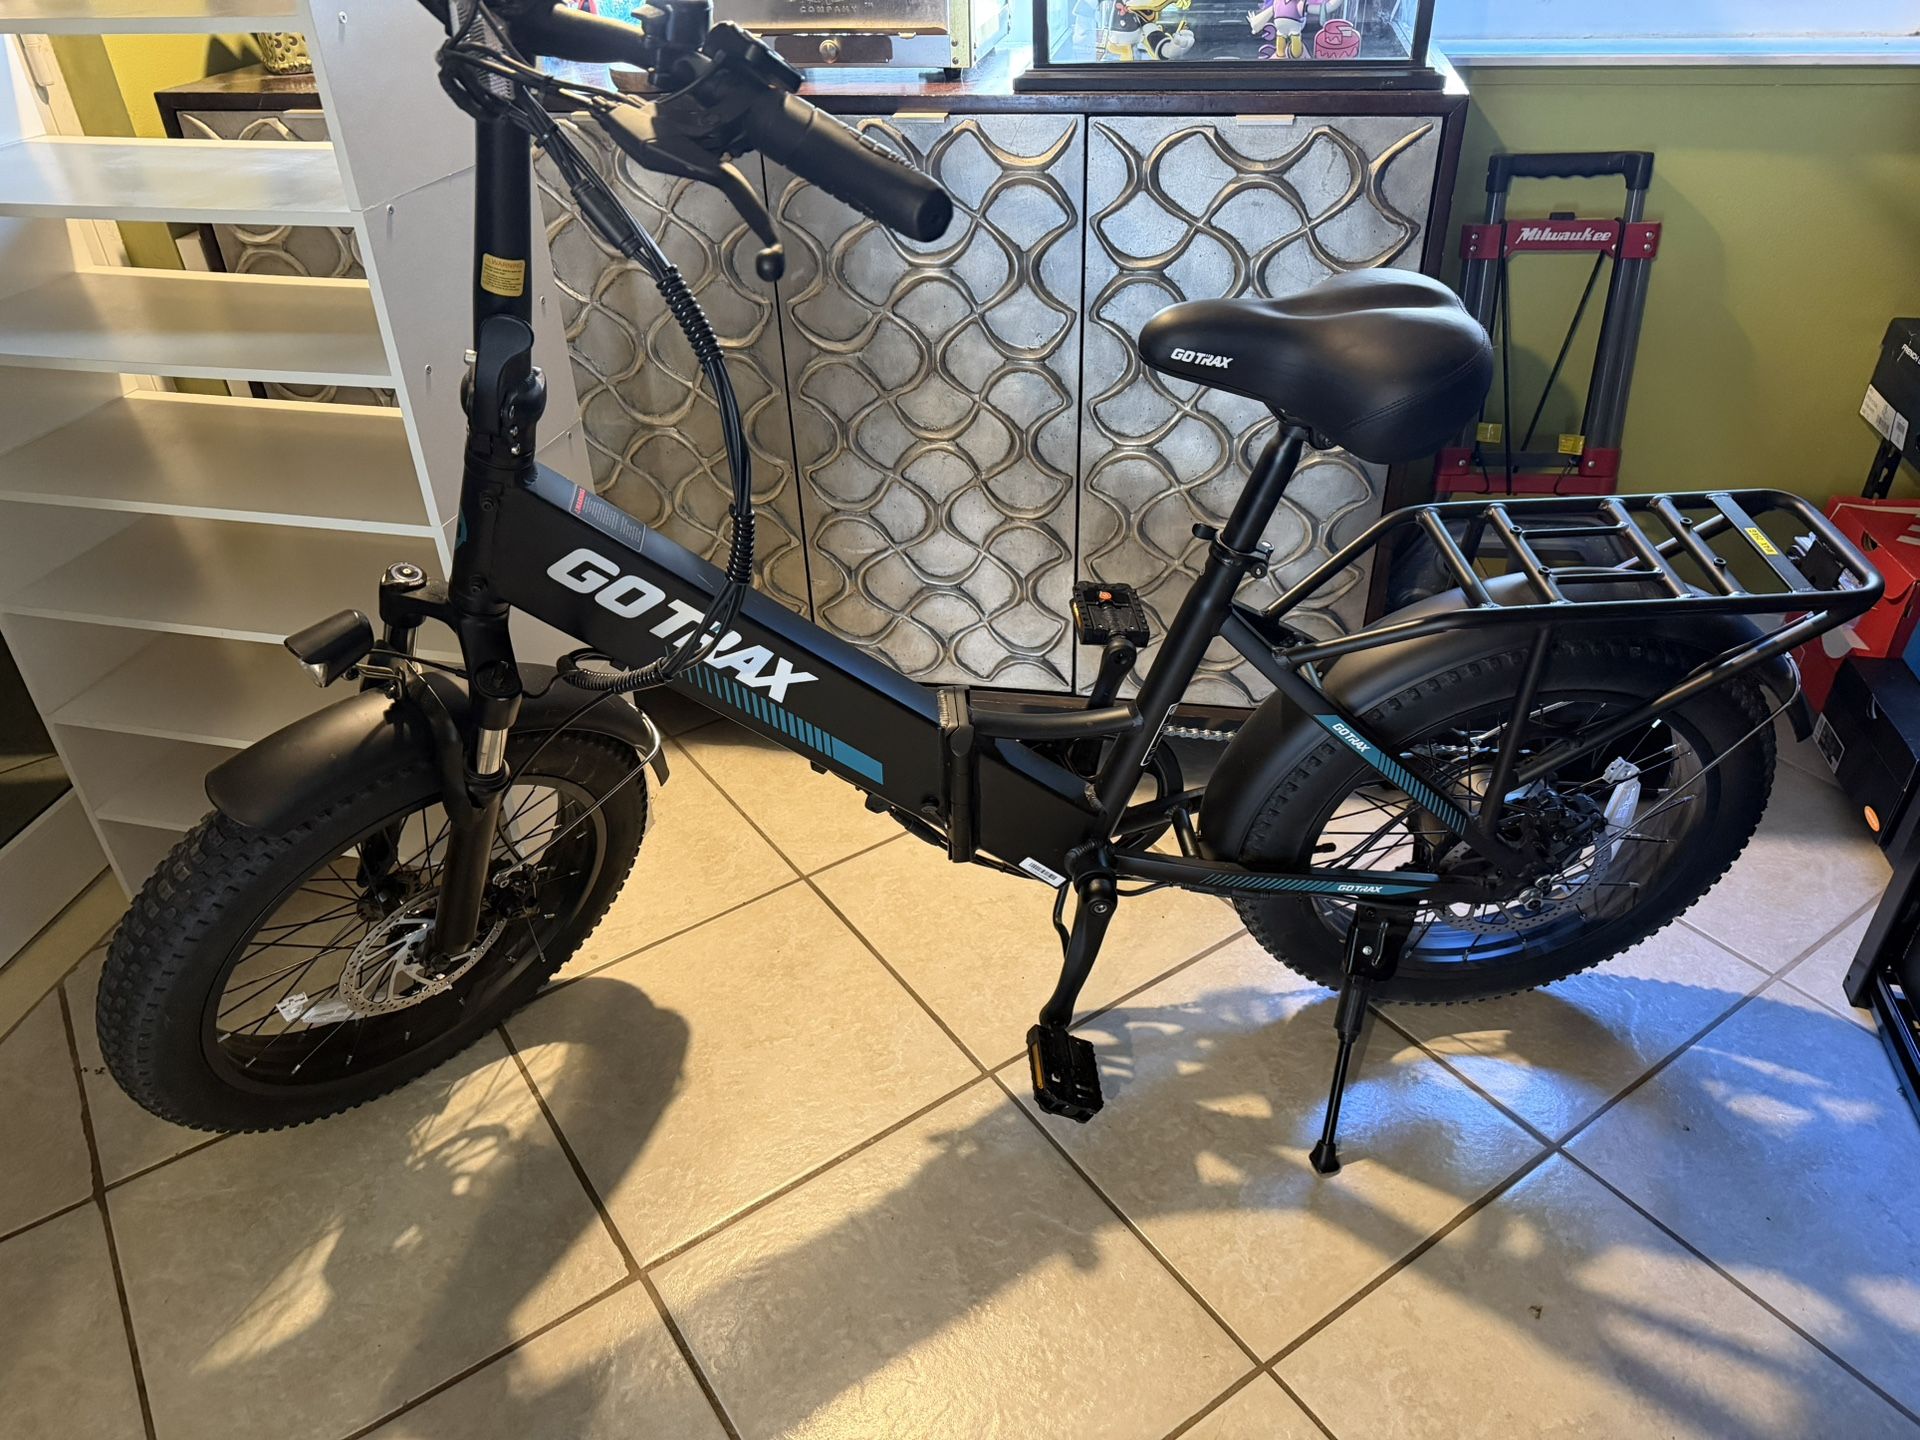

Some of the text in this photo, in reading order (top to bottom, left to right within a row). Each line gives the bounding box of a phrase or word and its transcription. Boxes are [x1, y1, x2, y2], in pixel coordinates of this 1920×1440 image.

[800, 5, 857, 13] COMPANY
[1515, 227, 1611, 244] Milwaukee
[1170, 347, 1233, 369] GOTRAX
[1332, 722, 1371, 752] GOTRAX
[1337, 884, 1383, 893] GOTRAX
